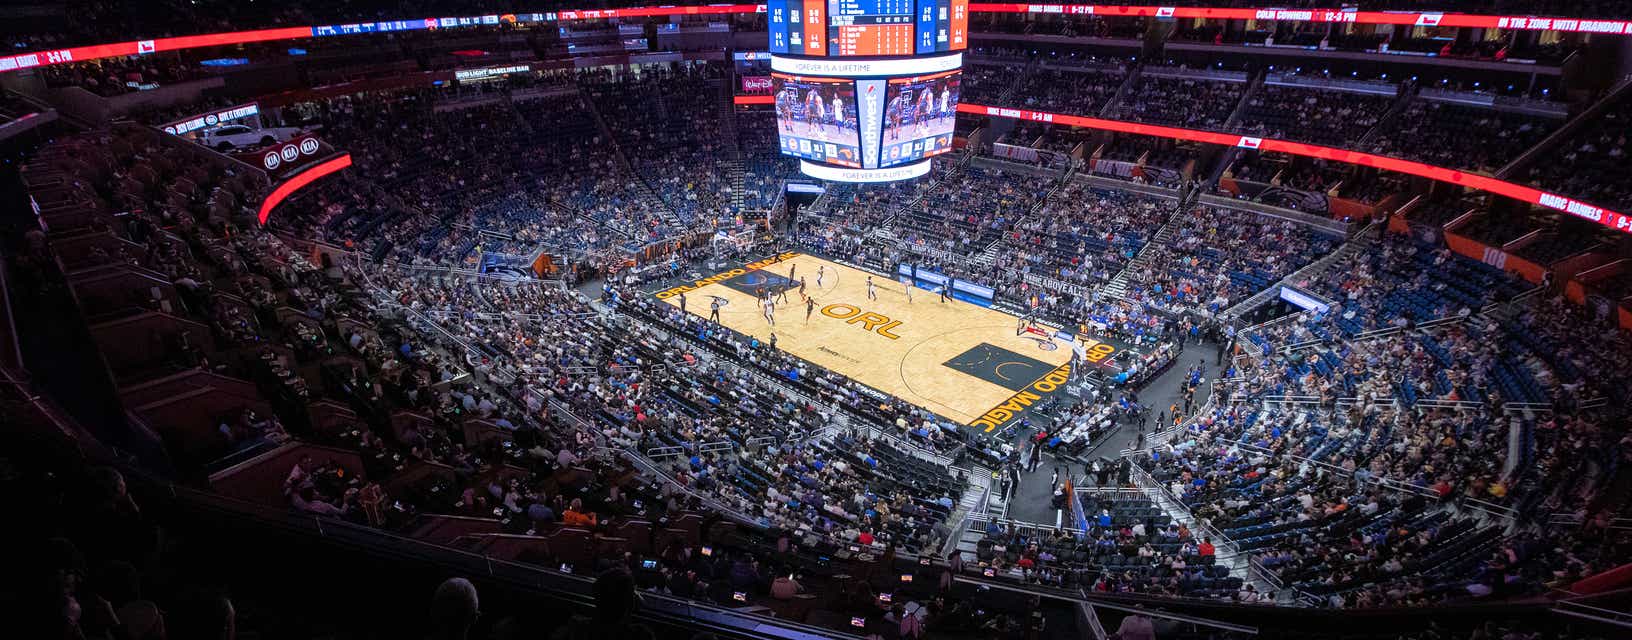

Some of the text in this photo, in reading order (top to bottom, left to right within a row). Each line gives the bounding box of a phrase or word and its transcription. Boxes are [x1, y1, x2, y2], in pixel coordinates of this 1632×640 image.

[1085, 6, 1094, 14] PM
[1256, 10, 1356, 22] COLIN COWHERD 12-3 PM
[1498, 17, 1509, 28] IN
[1510, 17, 1527, 29] THE
[1527, 18, 1552, 30] ZONE
[1552, 20, 1578, 31] WITH
[1578, 20, 1624, 32] BRANDON
[47, 52, 60, 63] 3-6
[60, 50, 72, 61] PM
[823, 64, 830, 72] IS
[838, 64, 870, 72] LIFETIME
[864, 93, 876, 164] Southwest
[301, 140, 317, 152] KIA
[283, 147, 297, 159] KIA
[266, 154, 278, 167] KIA
[1540, 193, 1567, 210] MARC
[1567, 201, 1602, 221] DANIELS
[1482, 247, 1506, 269] 108
[656, 268, 746, 299] ORLANDO
[1042, 280, 1067, 292] ABOVE
[820, 304, 903, 340] ORL
[970, 344, 1115, 432] ORNDO MAGIC
